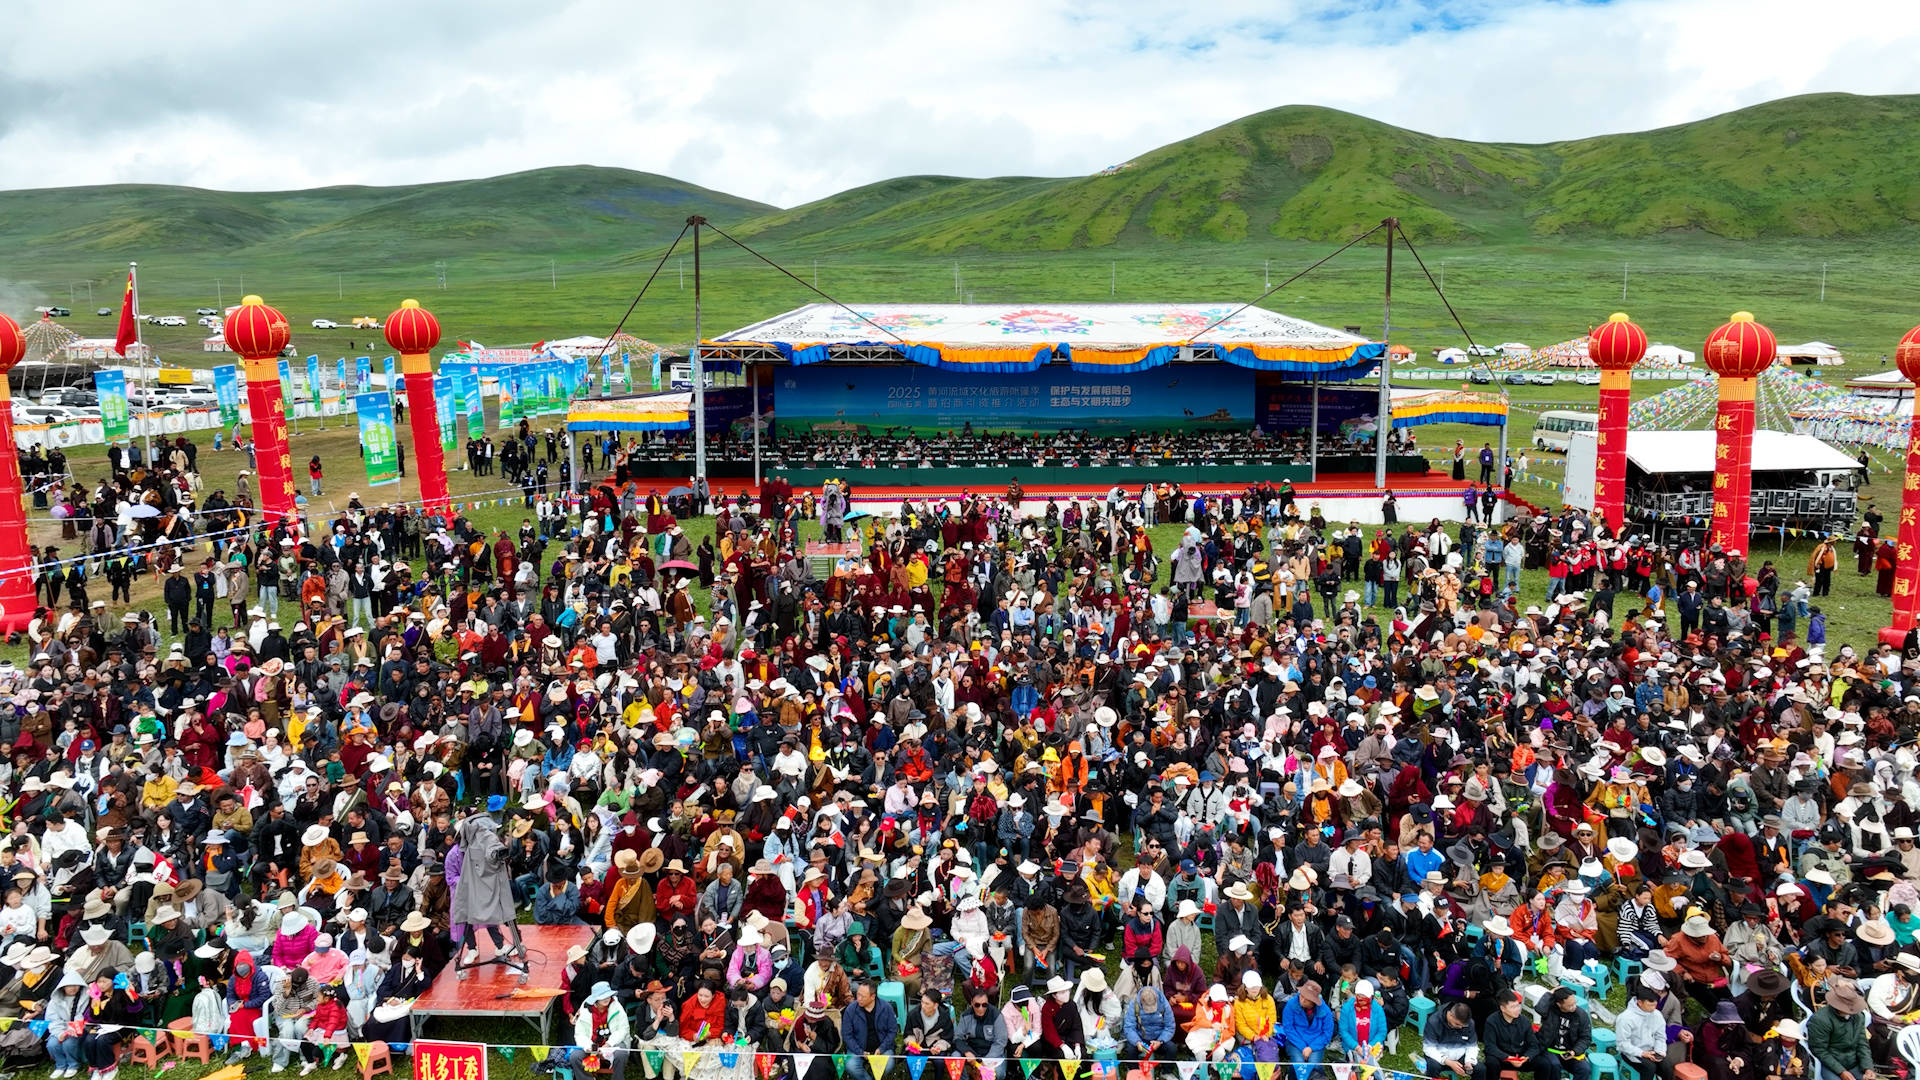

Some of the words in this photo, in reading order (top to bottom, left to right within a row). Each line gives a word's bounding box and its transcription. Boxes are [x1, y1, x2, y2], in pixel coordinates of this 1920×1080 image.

[887, 386, 921, 399] 2025
[1050, 385, 1132, 396] 保护与发展相融合
[1050, 396, 1132, 407] 生态与文明共进步
[1712, 414, 1731, 546] 投资新热土
[1893, 437, 1920, 597] 文旅兴家园
